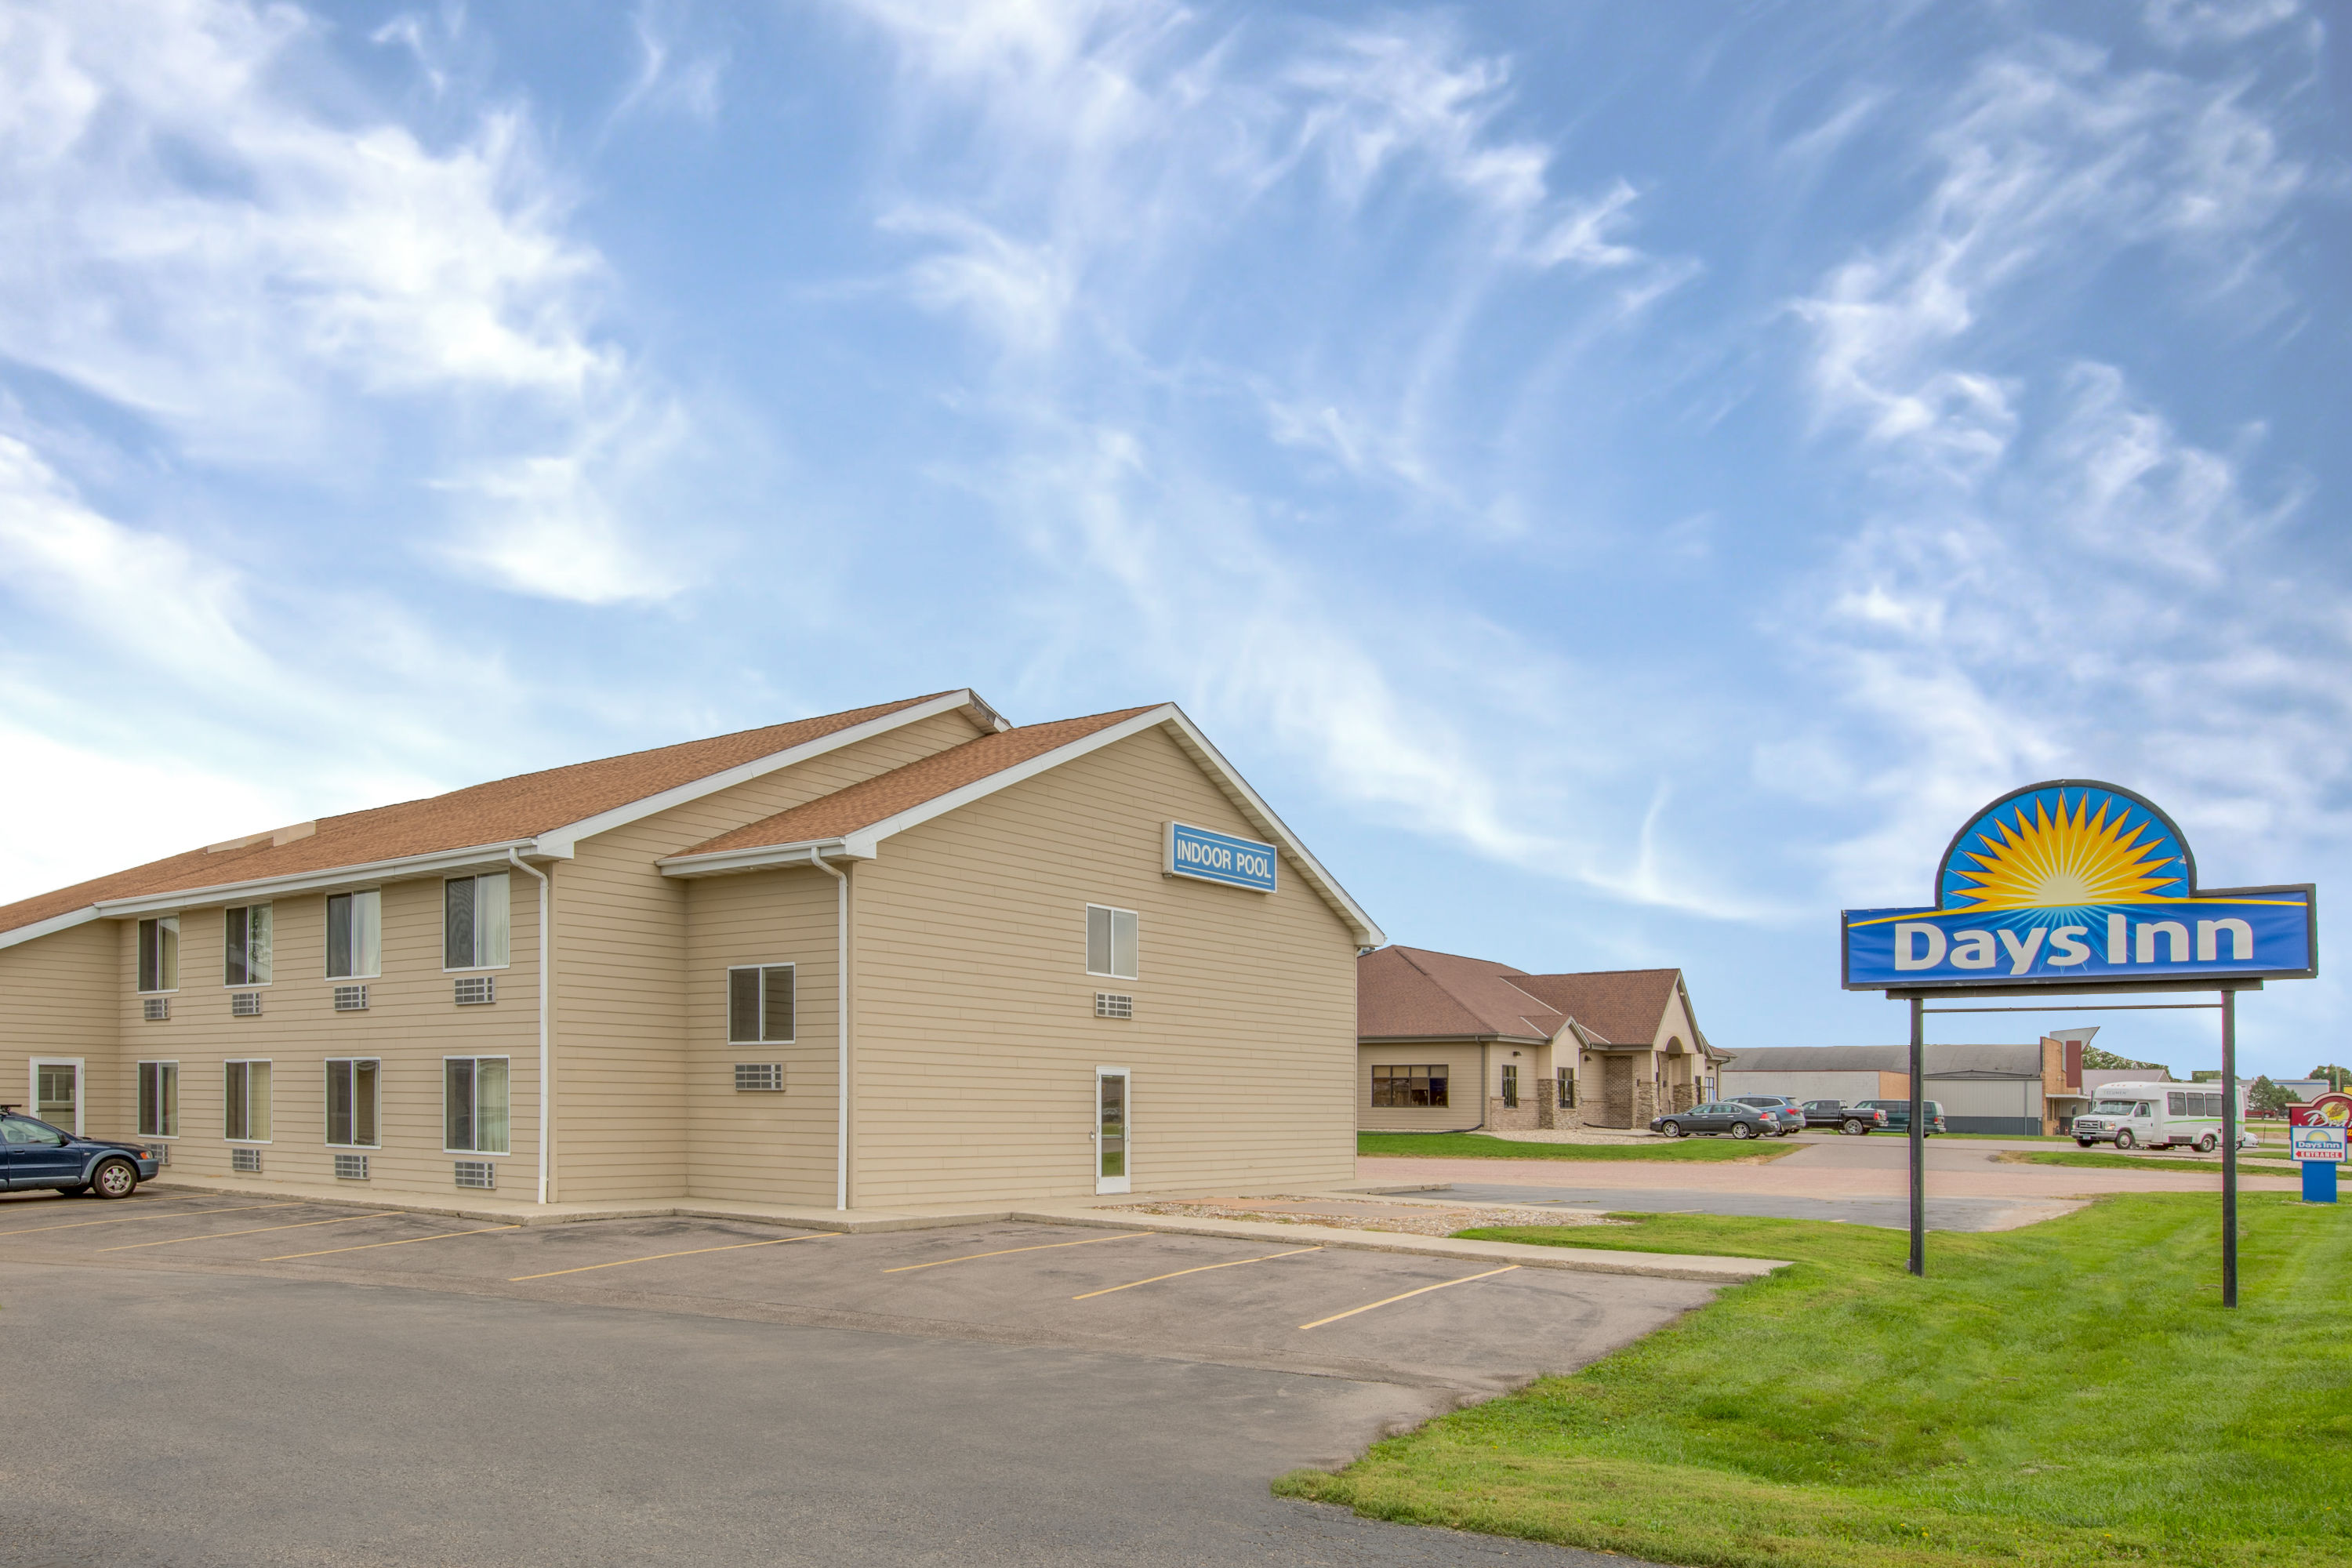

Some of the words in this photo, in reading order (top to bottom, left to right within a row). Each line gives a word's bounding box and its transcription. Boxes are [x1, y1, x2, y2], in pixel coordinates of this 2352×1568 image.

[1177, 839, 1231, 870] INDOOR
[1236, 852, 1271, 878] POOL
[1895, 923, 2091, 975] Days
[2107, 913, 2252, 964] Inn
